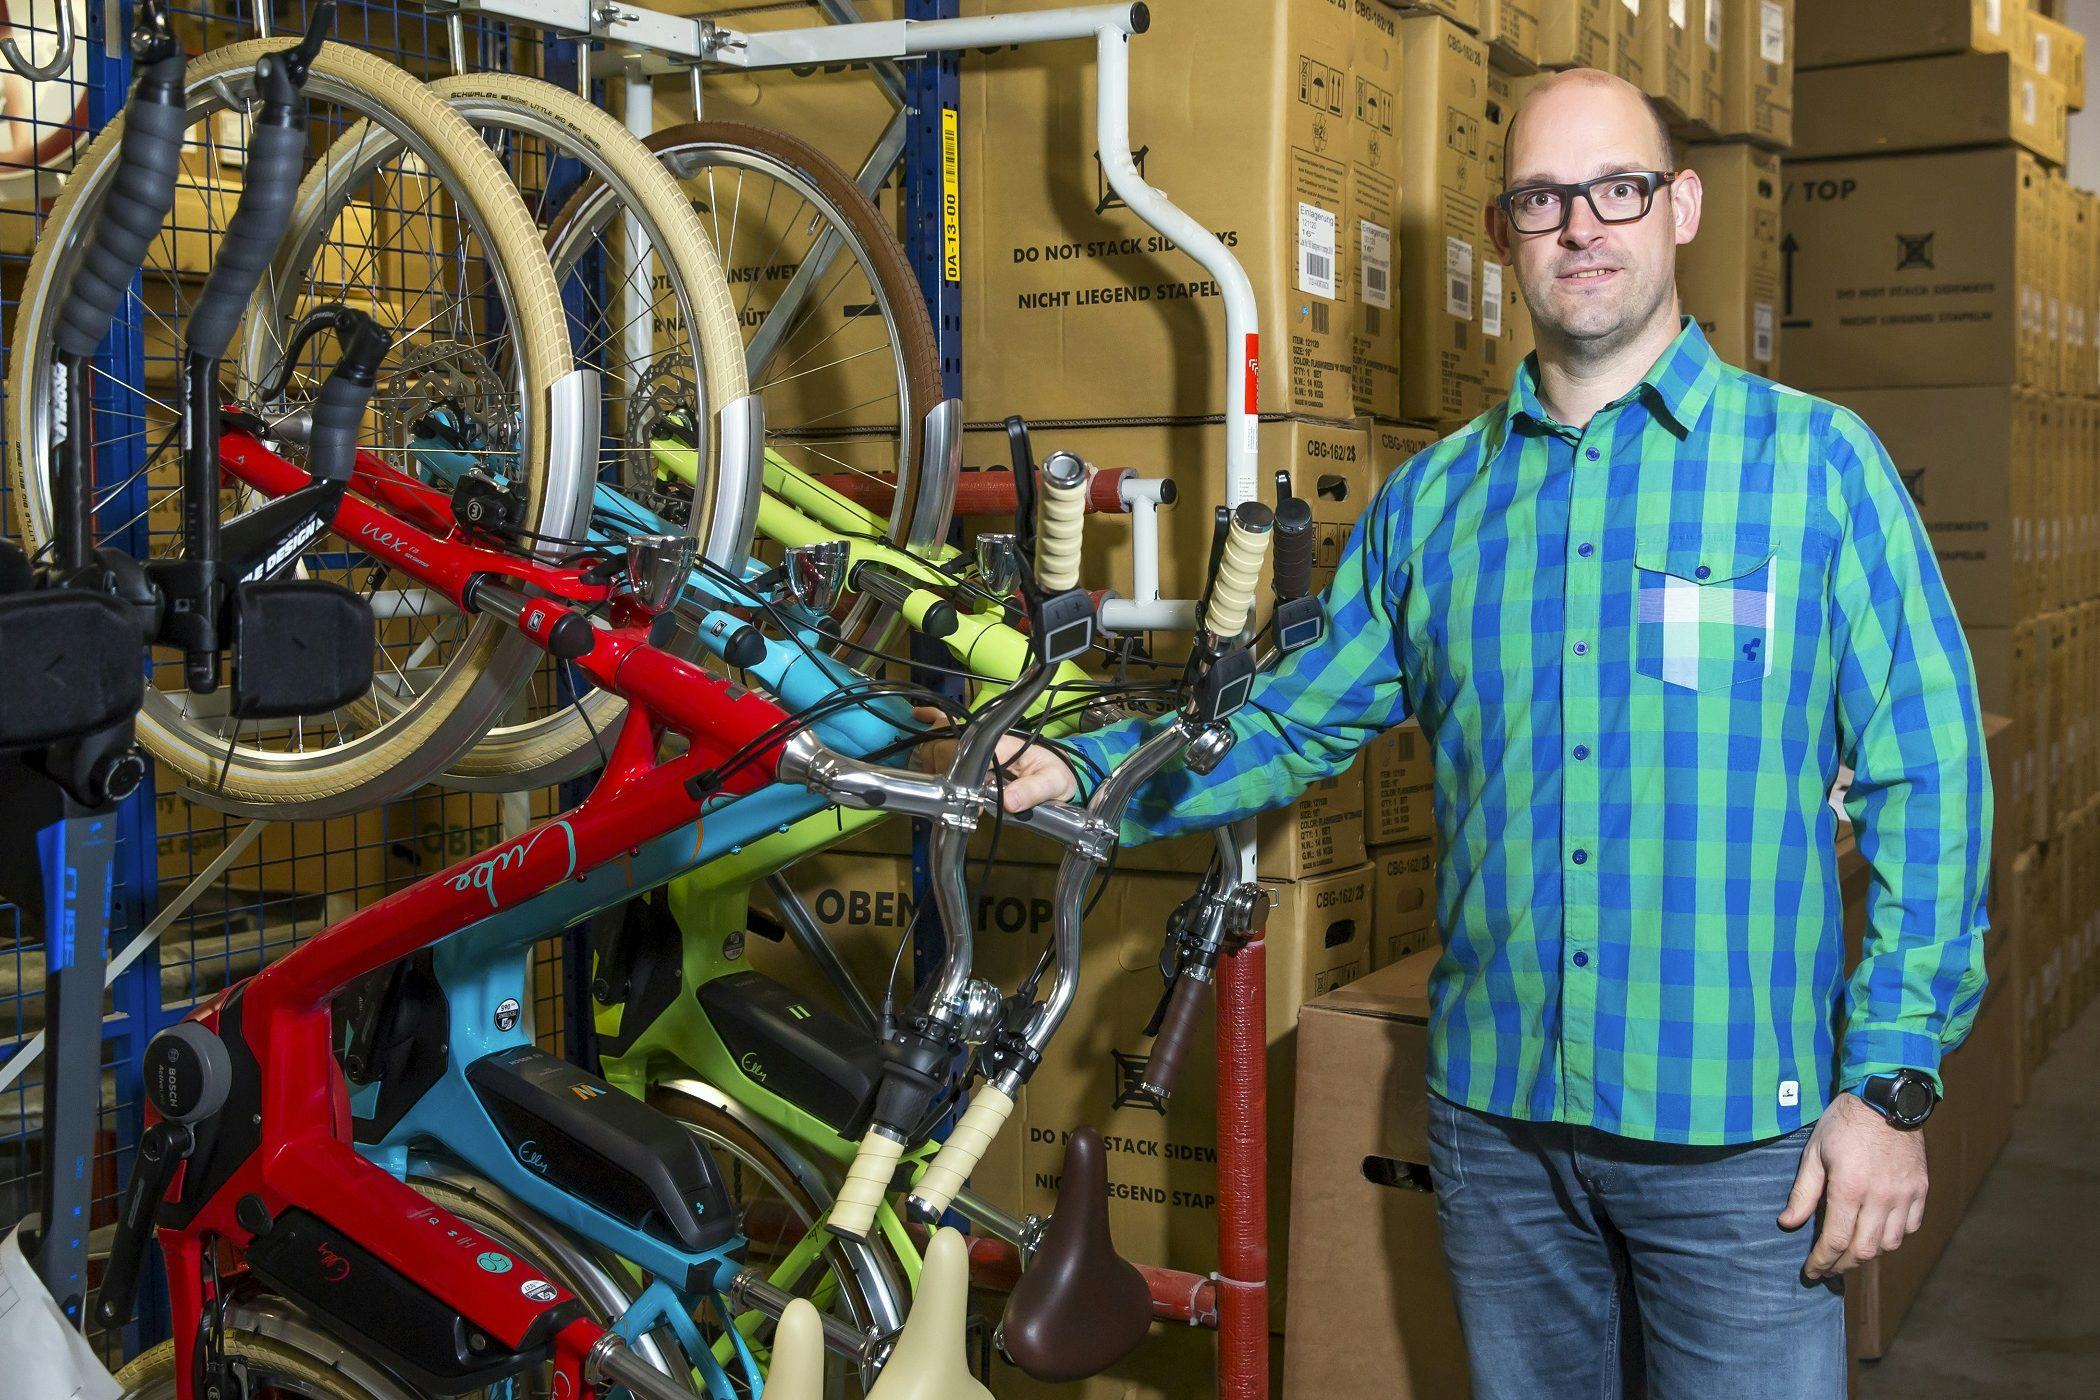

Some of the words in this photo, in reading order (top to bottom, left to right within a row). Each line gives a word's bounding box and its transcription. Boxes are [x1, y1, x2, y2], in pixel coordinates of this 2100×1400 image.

[450, 91, 498, 99] SCHWALBE
[1803, 180, 1856, 201] TOP
[1300, 205, 1334, 227] Einlagerung
[1013, 247, 1039, 263] DO
[1045, 244, 1081, 261] NOT
[1087, 238, 1142, 258] STACK
[1147, 231, 1238, 252] SIDYS
[1018, 291, 1071, 309] NICHT
[1076, 286, 1150, 306] LIEGEND
[1156, 281, 1223, 300] STAPEL
[265, 519, 316, 573] DESIGN
[168, 1067, 179, 1108] BOSCH
[1030, 1127, 1056, 1145] DO
[1103, 1136, 1159, 1157] STACK
[1164, 1143, 1217, 1165] SIDEW
[1107, 1183, 1167, 1204] EGEND
[1172, 1191, 1217, 1209] STAP
